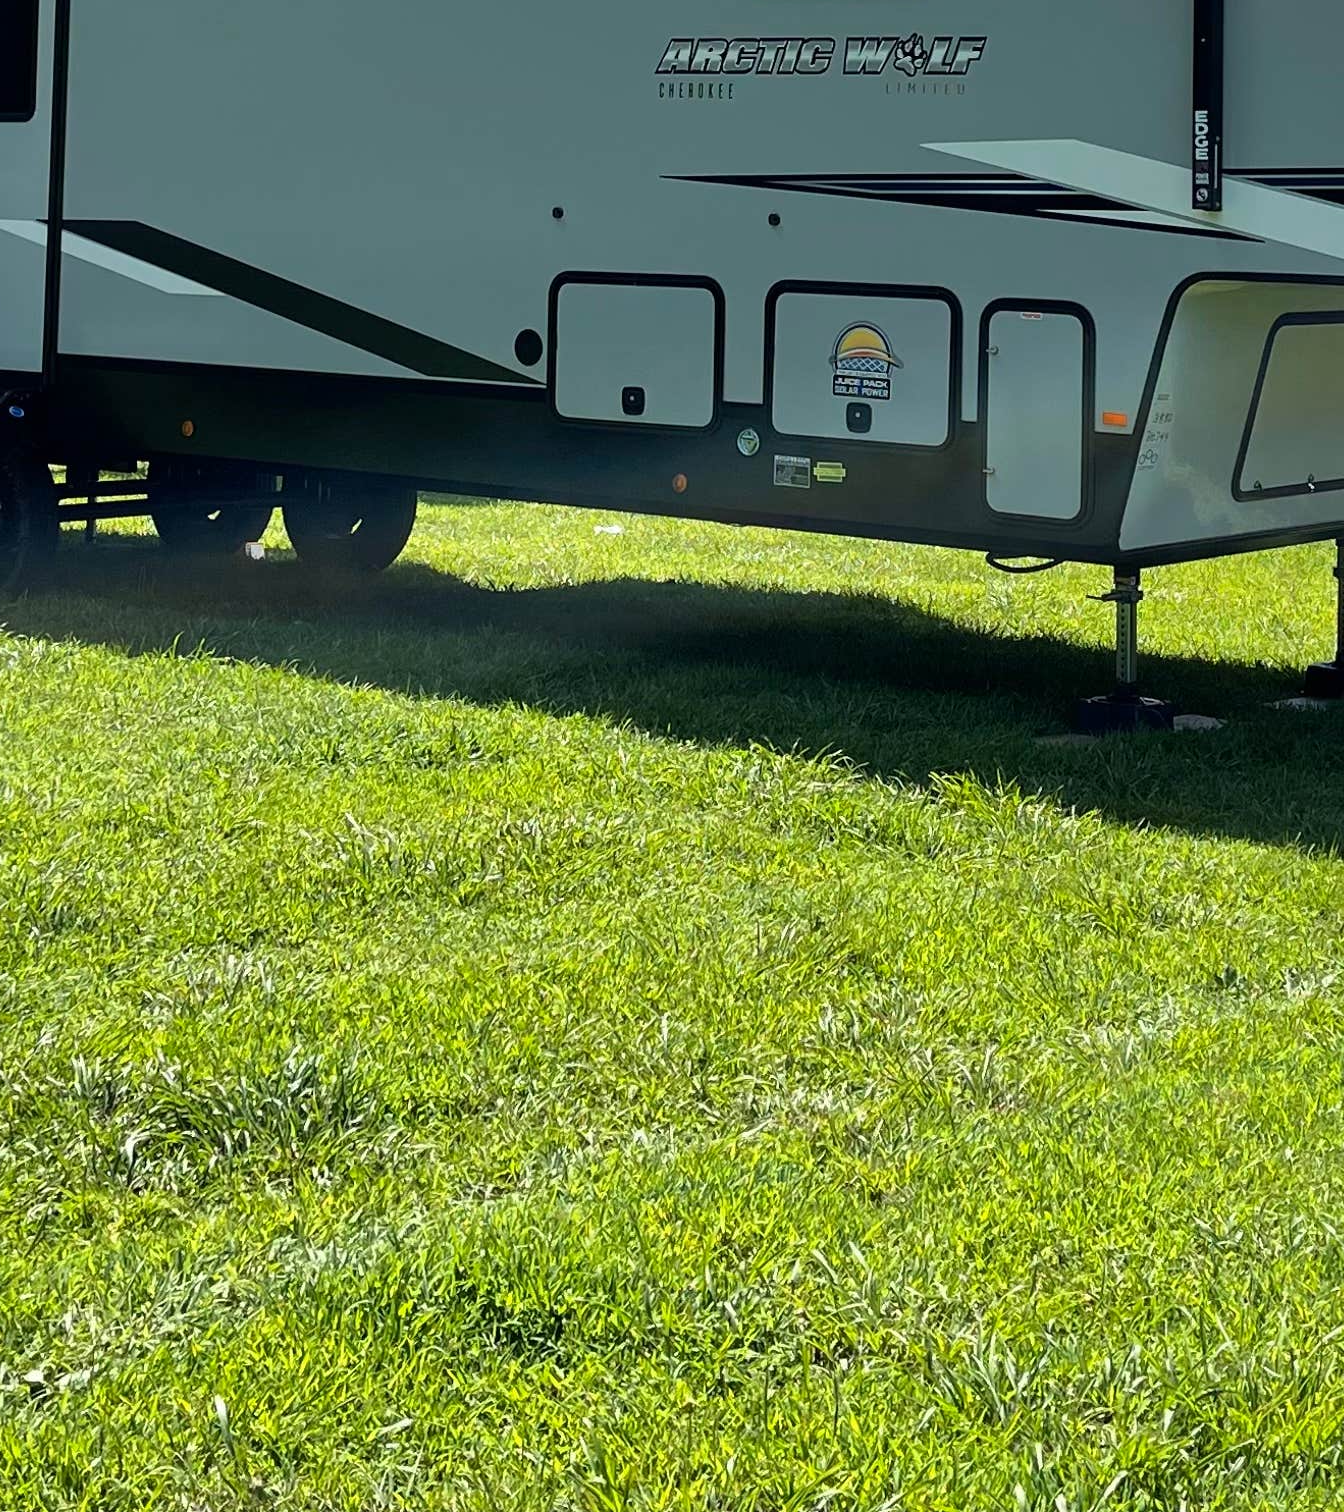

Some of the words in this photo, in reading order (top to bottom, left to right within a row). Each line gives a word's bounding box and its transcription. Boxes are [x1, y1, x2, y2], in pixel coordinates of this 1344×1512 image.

[655, 37, 836, 76] ARCTIC
[658, 81, 735, 100] CHEROKEE
[1194, 110, 1209, 161] EDGE
[834, 377, 862, 387] JUICE
[862, 379, 889, 389] PACK
[861, 387, 889, 398] POWER
